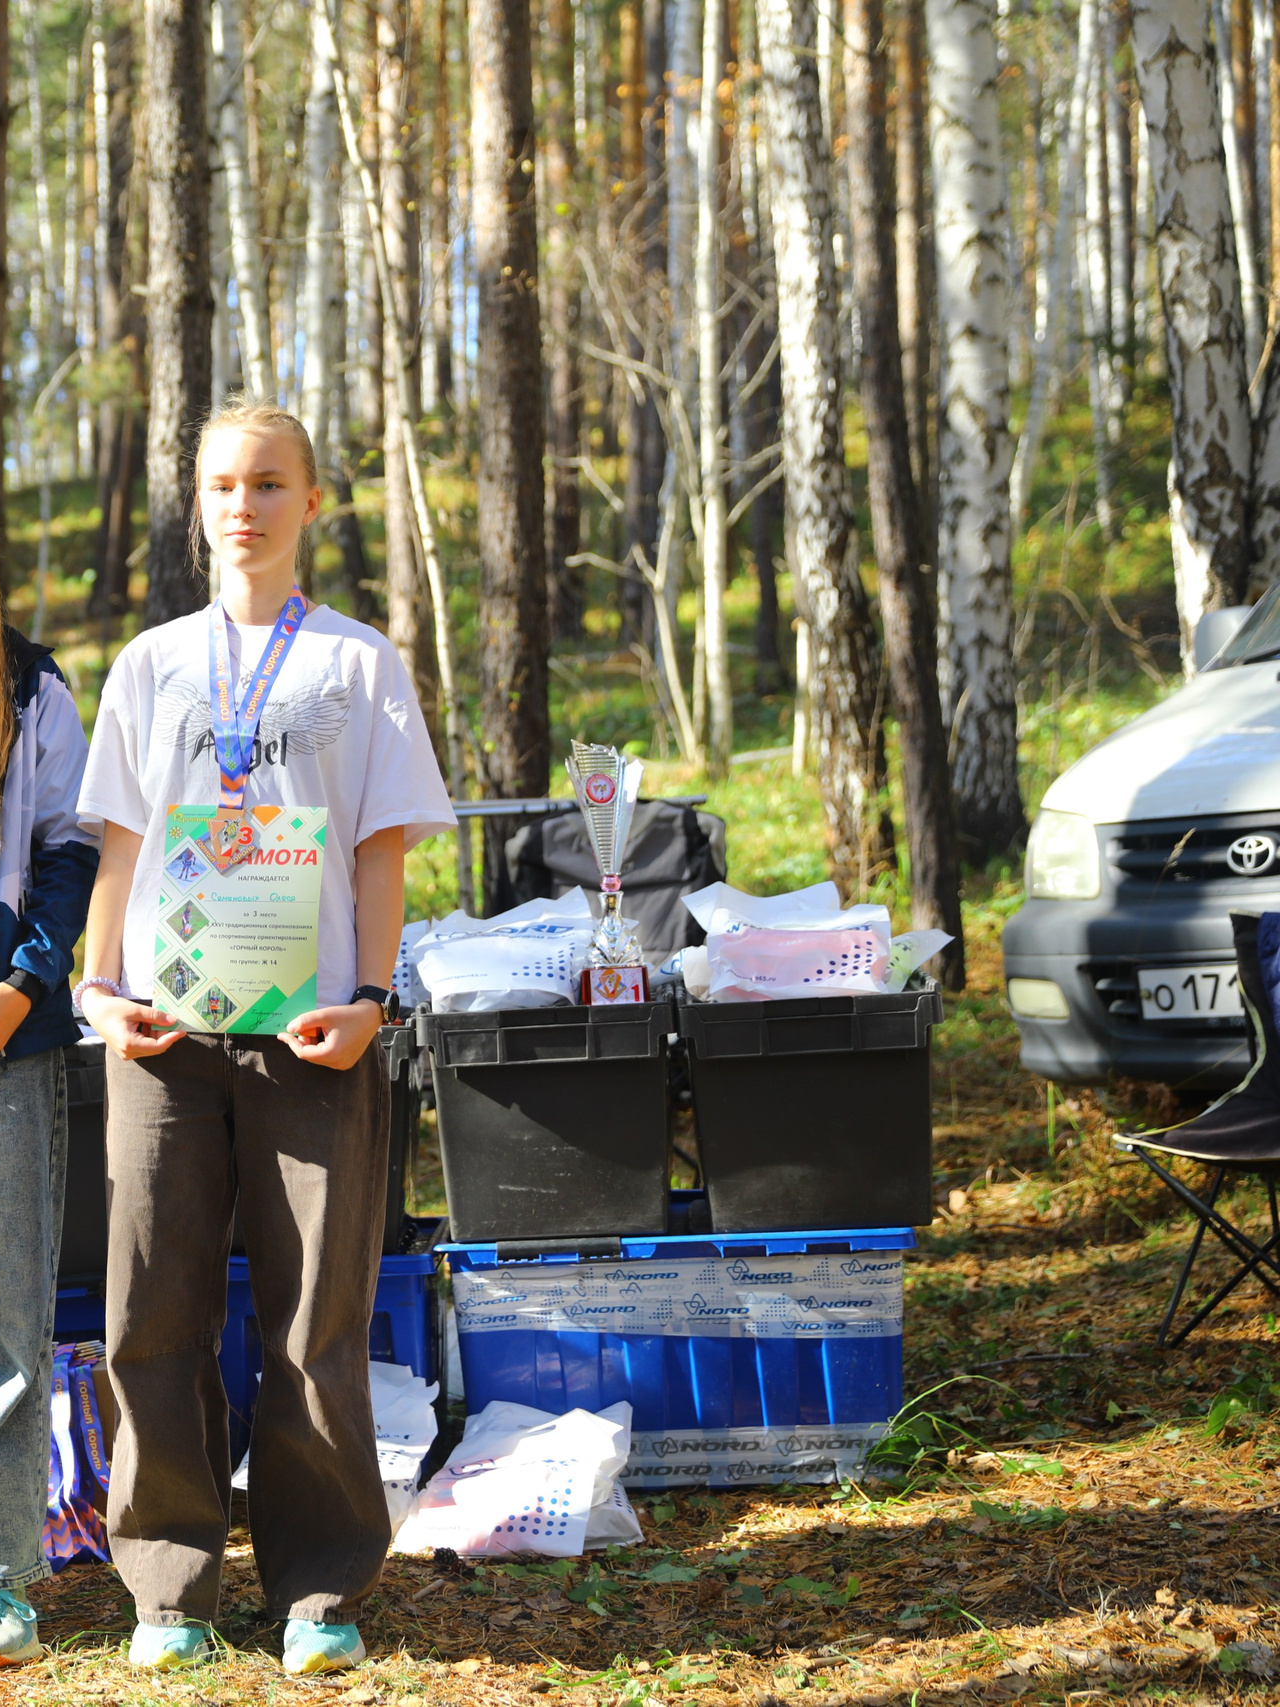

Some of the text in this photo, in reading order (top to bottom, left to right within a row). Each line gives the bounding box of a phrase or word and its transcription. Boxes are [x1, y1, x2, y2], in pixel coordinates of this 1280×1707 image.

[244, 679, 268, 721] ГОРНЫЙ
[262, 638, 286, 677] КОРОЛЬ
[189, 727, 289, 775] Agel
[237, 826, 253, 845] 3
[195, 838, 255, 865] ГОРНЫЙ КОРОЛЬ
[630, 984, 640, 1002] 1
[626, 1272, 679, 1281] NORD
[741, 1272, 793, 1281] NORD
[476, 1294, 528, 1306] NORD
[819, 1300, 873, 1309] NORD
[583, 1305, 637, 1314] NORD
[698, 1306, 750, 1316] NORD
[466, 1314, 517, 1325] NORD
[794, 1322, 847, 1331] NORD
[78, 1381, 102, 1471] ГОРНЫЙ КОРОЛЬ
[681, 1440, 761, 1451] NORD
[632, 1465, 712, 1477] NORD
[756, 1462, 835, 1474] NORD
